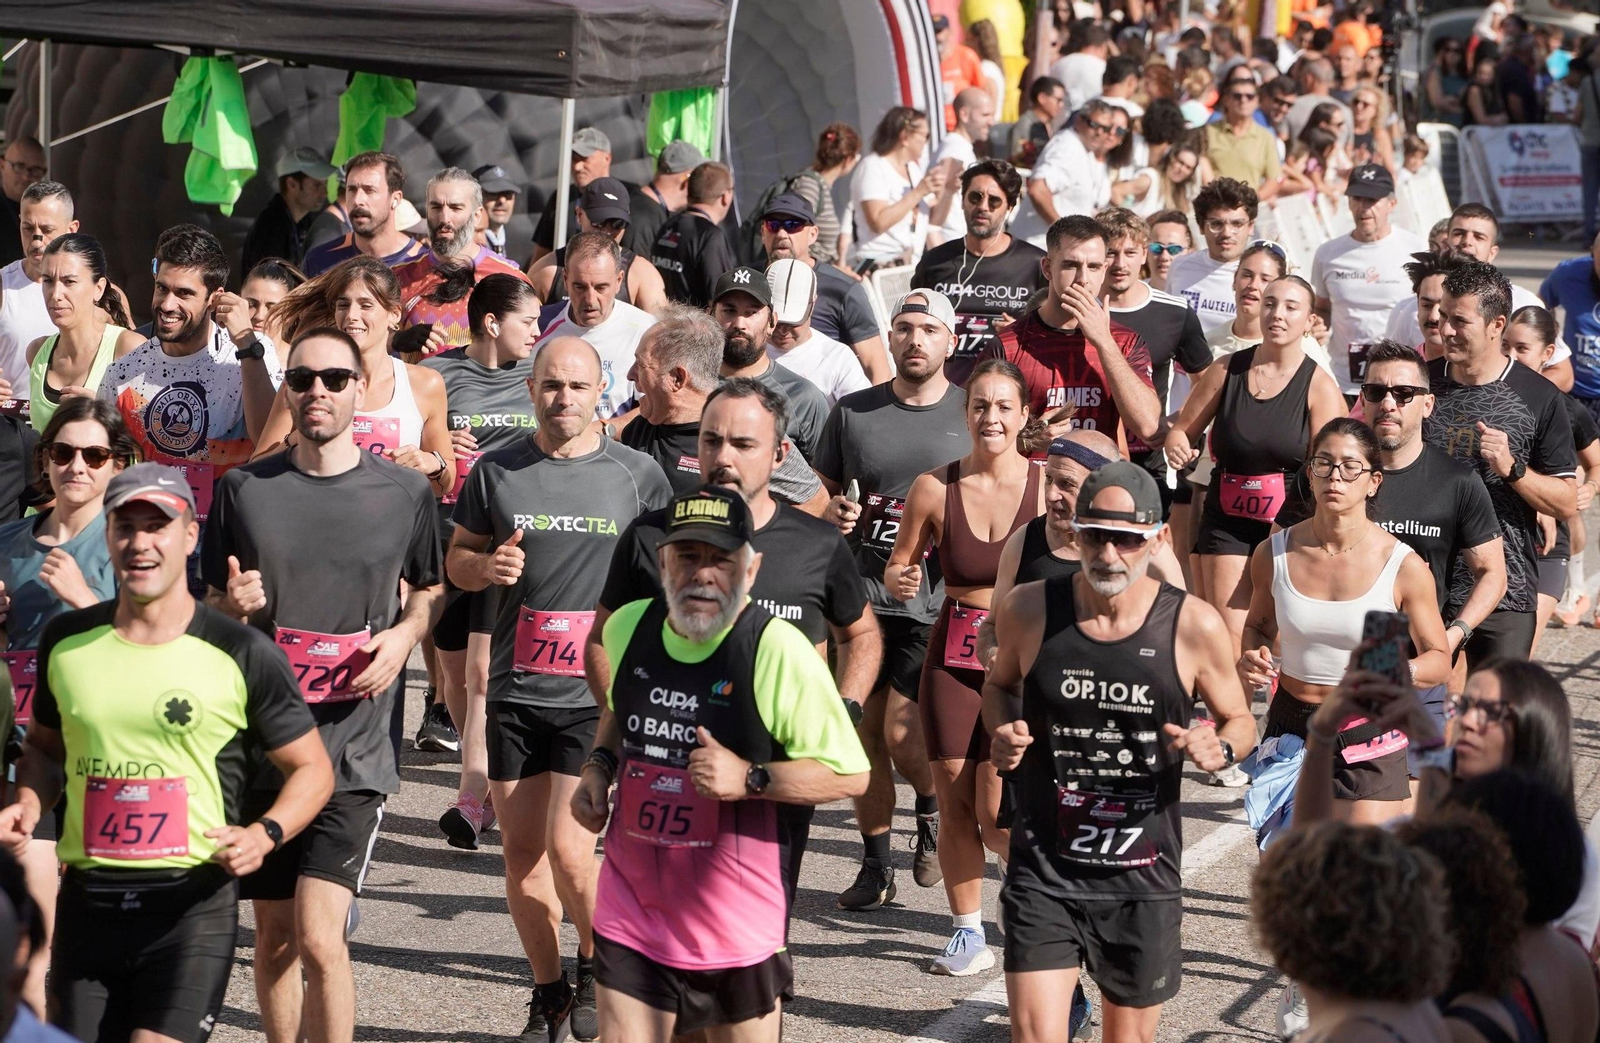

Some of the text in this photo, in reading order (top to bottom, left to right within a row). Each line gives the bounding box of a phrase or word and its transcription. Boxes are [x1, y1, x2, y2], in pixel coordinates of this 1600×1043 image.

[984, 299, 1007, 307] Since
[177, 391, 201, 421] ORIXES
[1046, 387, 1102, 408] GAMES
[452, 414, 538, 429] PROXECTEA
[674, 498, 730, 519] EL PATRÓN
[1231, 495, 1274, 515] 407
[513, 513, 618, 536] PROXECTEA
[547, 619, 570, 628] CAE
[314, 641, 340, 651] CAE
[530, 638, 577, 666] 714
[293, 662, 352, 692] 720
[649, 686, 700, 712] CUPA
[627, 714, 641, 733] O
[643, 716, 712, 744] BARC
[99, 812, 168, 844] 457
[637, 800, 694, 836] 615
[1070, 824, 1144, 855] 217
